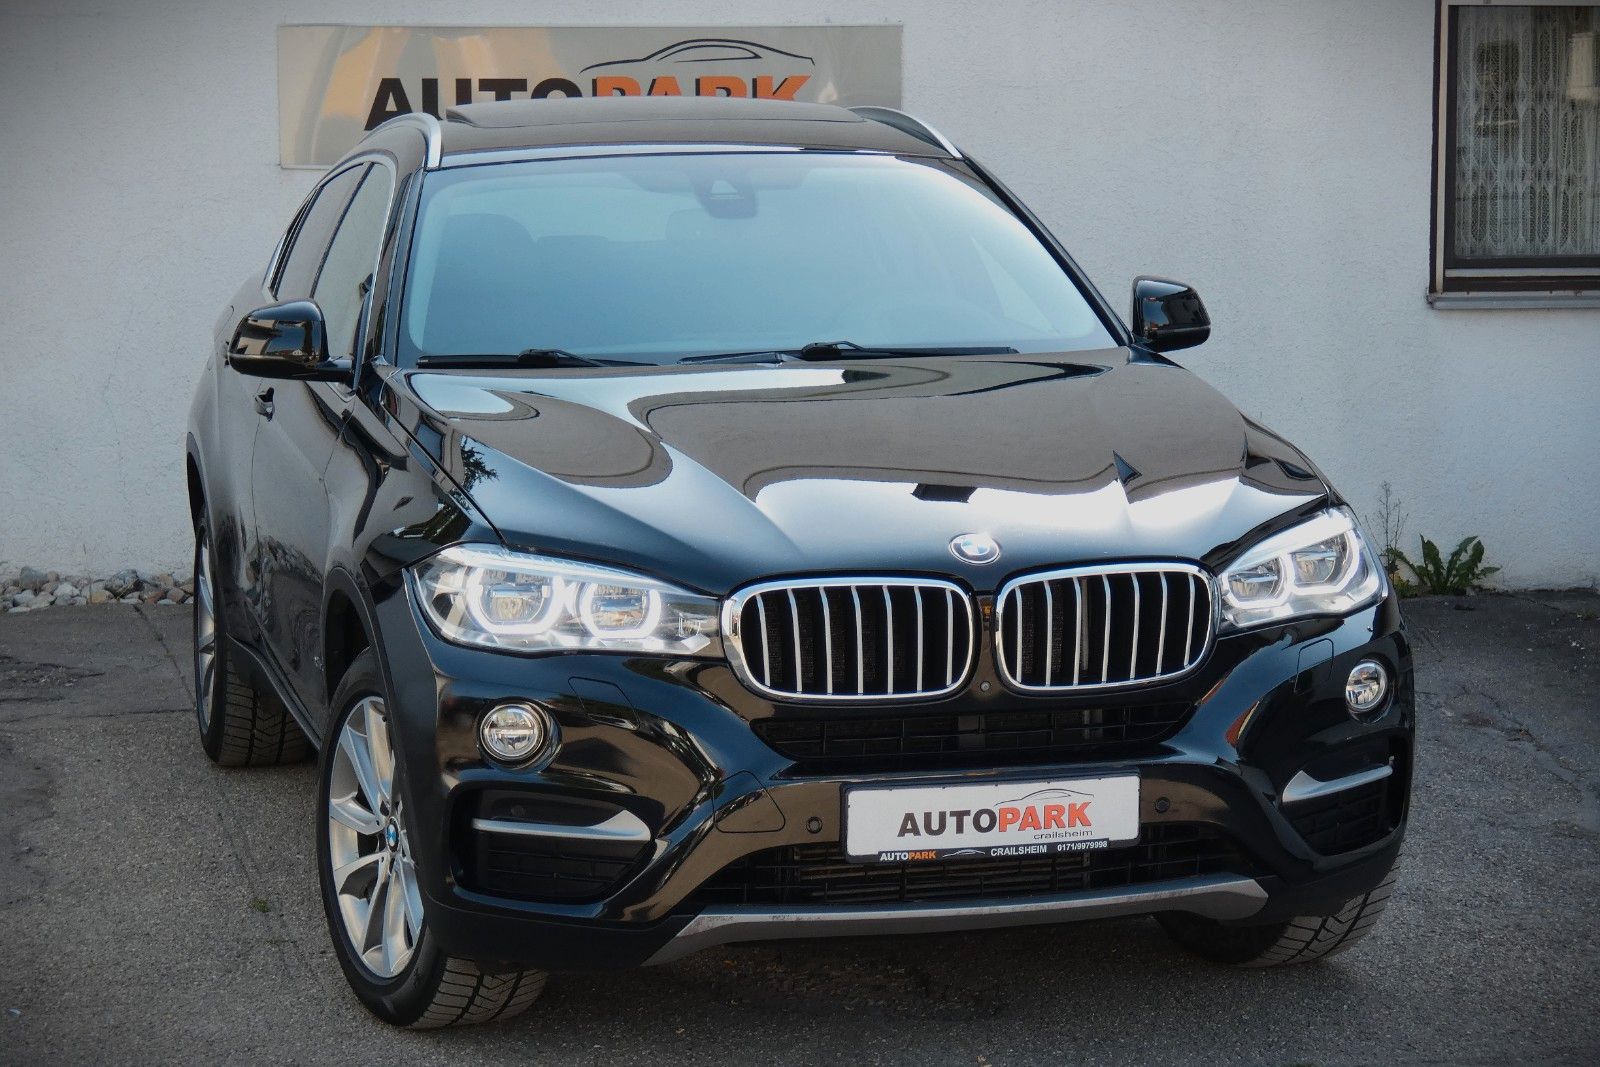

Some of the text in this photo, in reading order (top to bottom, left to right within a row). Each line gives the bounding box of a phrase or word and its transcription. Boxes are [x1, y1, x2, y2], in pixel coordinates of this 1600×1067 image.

[897, 801, 1093, 838] AUTOPARK
[1033, 830, 1094, 840] crailsheim
[880, 840, 1108, 861] AUTOPARK CRAILSHEIM 0171/9979998
